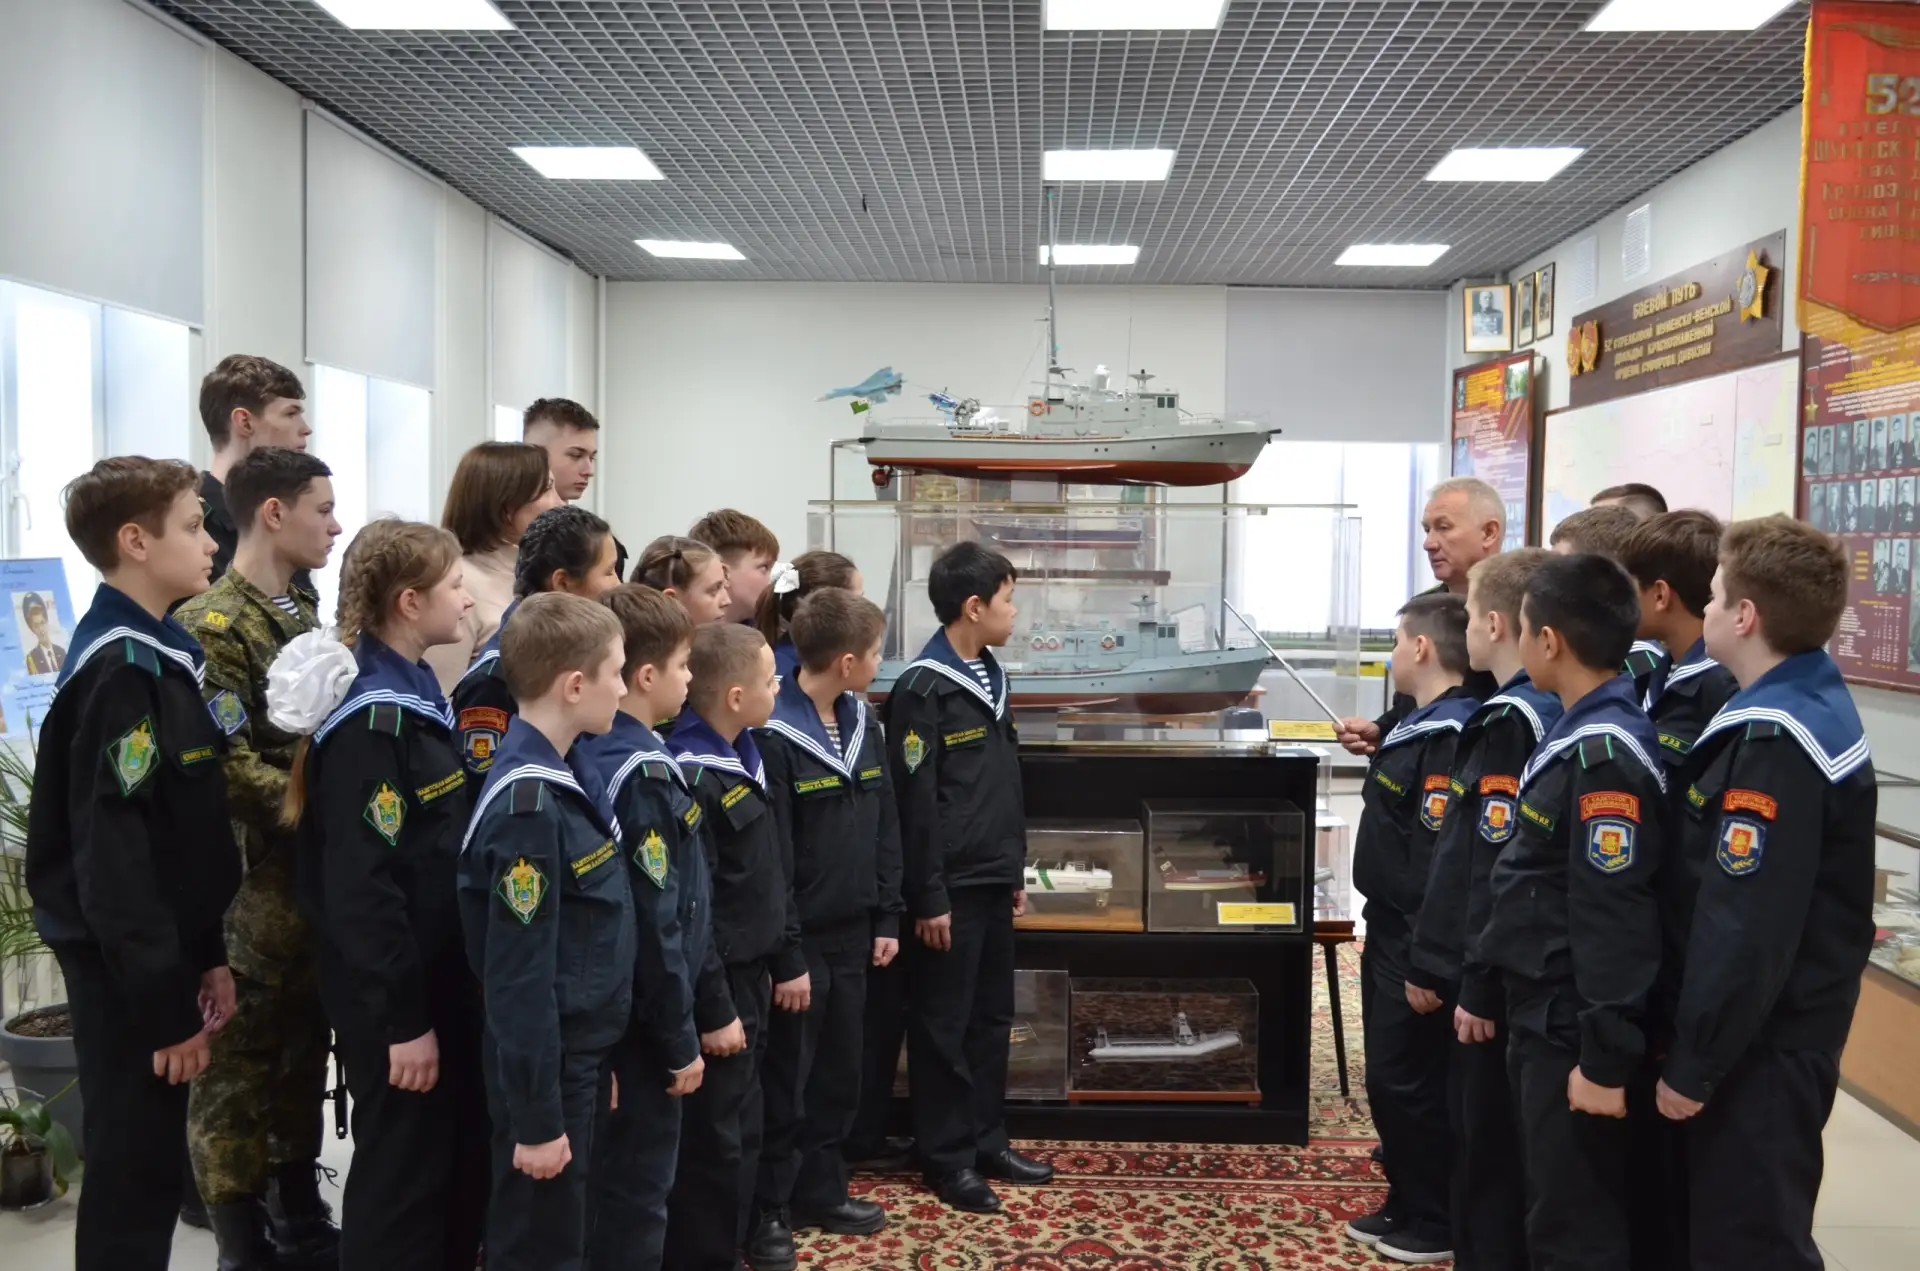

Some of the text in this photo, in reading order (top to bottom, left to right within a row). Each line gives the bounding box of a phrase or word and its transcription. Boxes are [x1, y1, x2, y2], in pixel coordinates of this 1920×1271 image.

[1867, 74, 1920, 116] 52
[1633, 282, 1700, 320] БОЕВОЙ ПУТЬ
